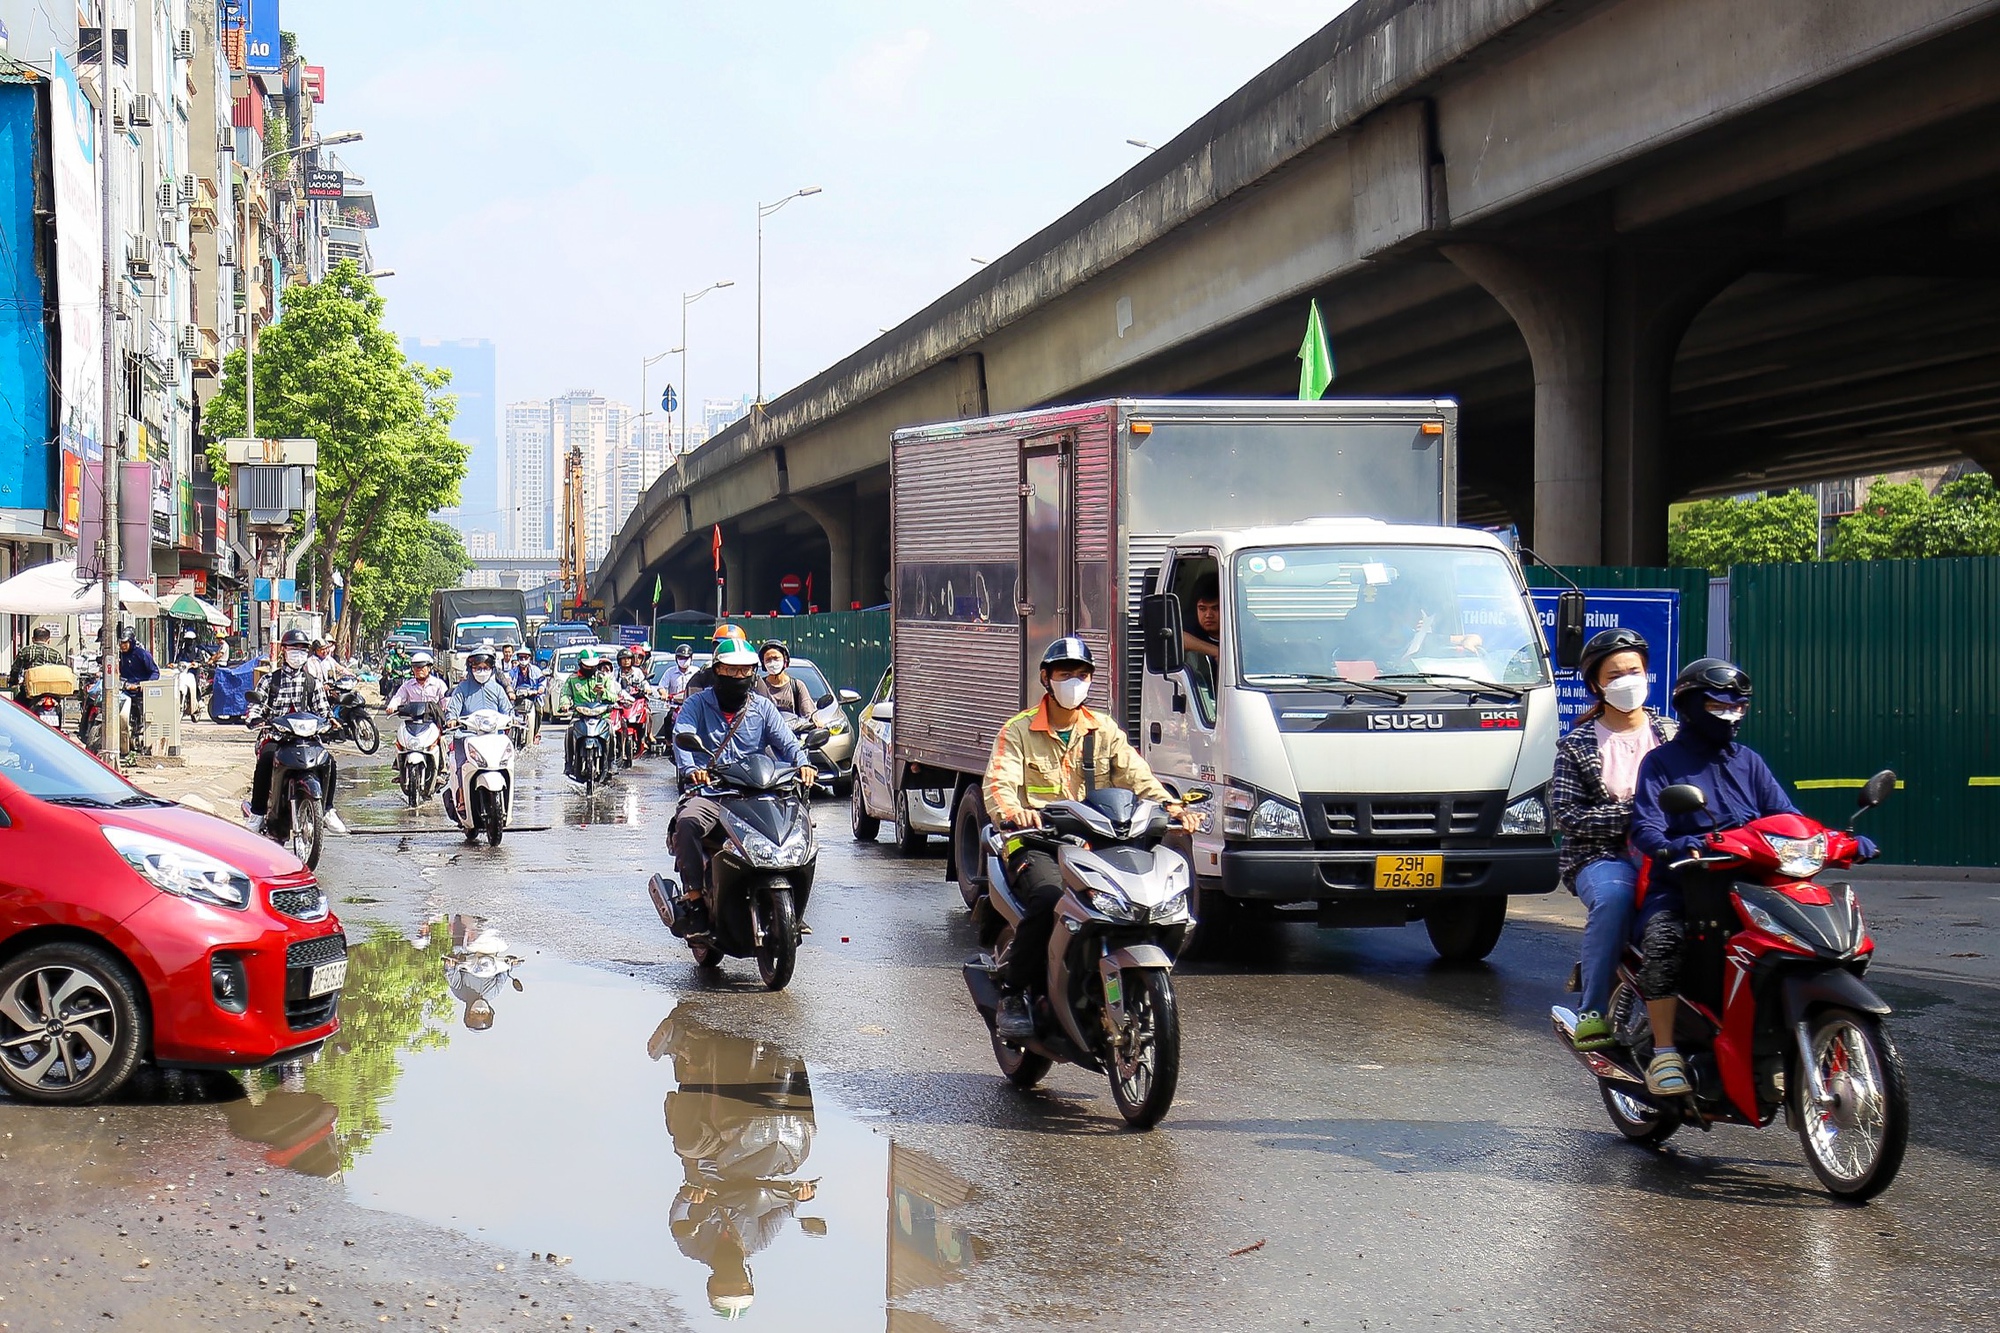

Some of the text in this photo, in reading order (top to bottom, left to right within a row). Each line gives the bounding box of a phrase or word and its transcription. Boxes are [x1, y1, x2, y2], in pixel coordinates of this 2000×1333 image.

[250, 40, 270, 57] ÁO
[312, 172, 338, 182] BẢO HỘ
[308, 181, 342, 190] LAO ĐỘNG
[1462, 608, 1507, 626] THÔNG
[1562, 684, 1572, 698] HÀ
[1573, 686, 1588, 701] NỘI.
[1557, 702, 1573, 715] ÔNG
[1366, 711, 1518, 730] ISUZU QKR
[1480, 719, 1521, 728] 270
[1200, 772, 1216, 782] 270
[1395, 857, 1425, 871] 29H
[1383, 872, 1435, 887] 784.38
